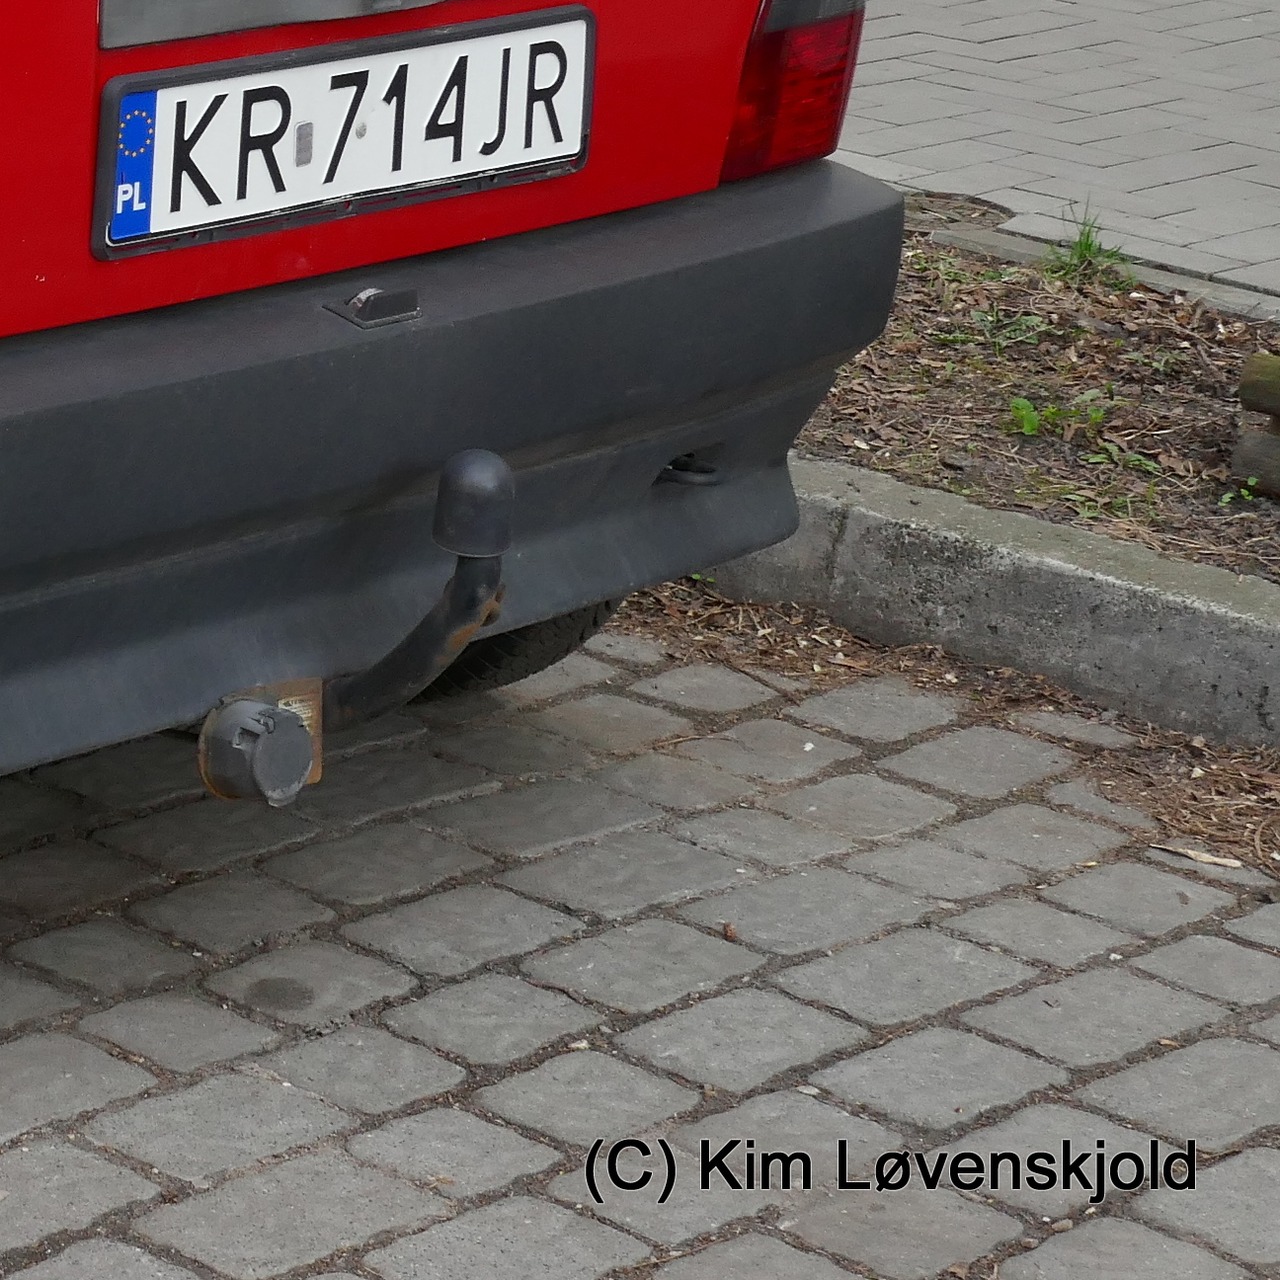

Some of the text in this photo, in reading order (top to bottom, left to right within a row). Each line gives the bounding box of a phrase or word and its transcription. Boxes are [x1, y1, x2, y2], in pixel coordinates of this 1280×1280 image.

[169, 39, 568, 213] KR 714JR
[116, 182, 147, 214] PL
